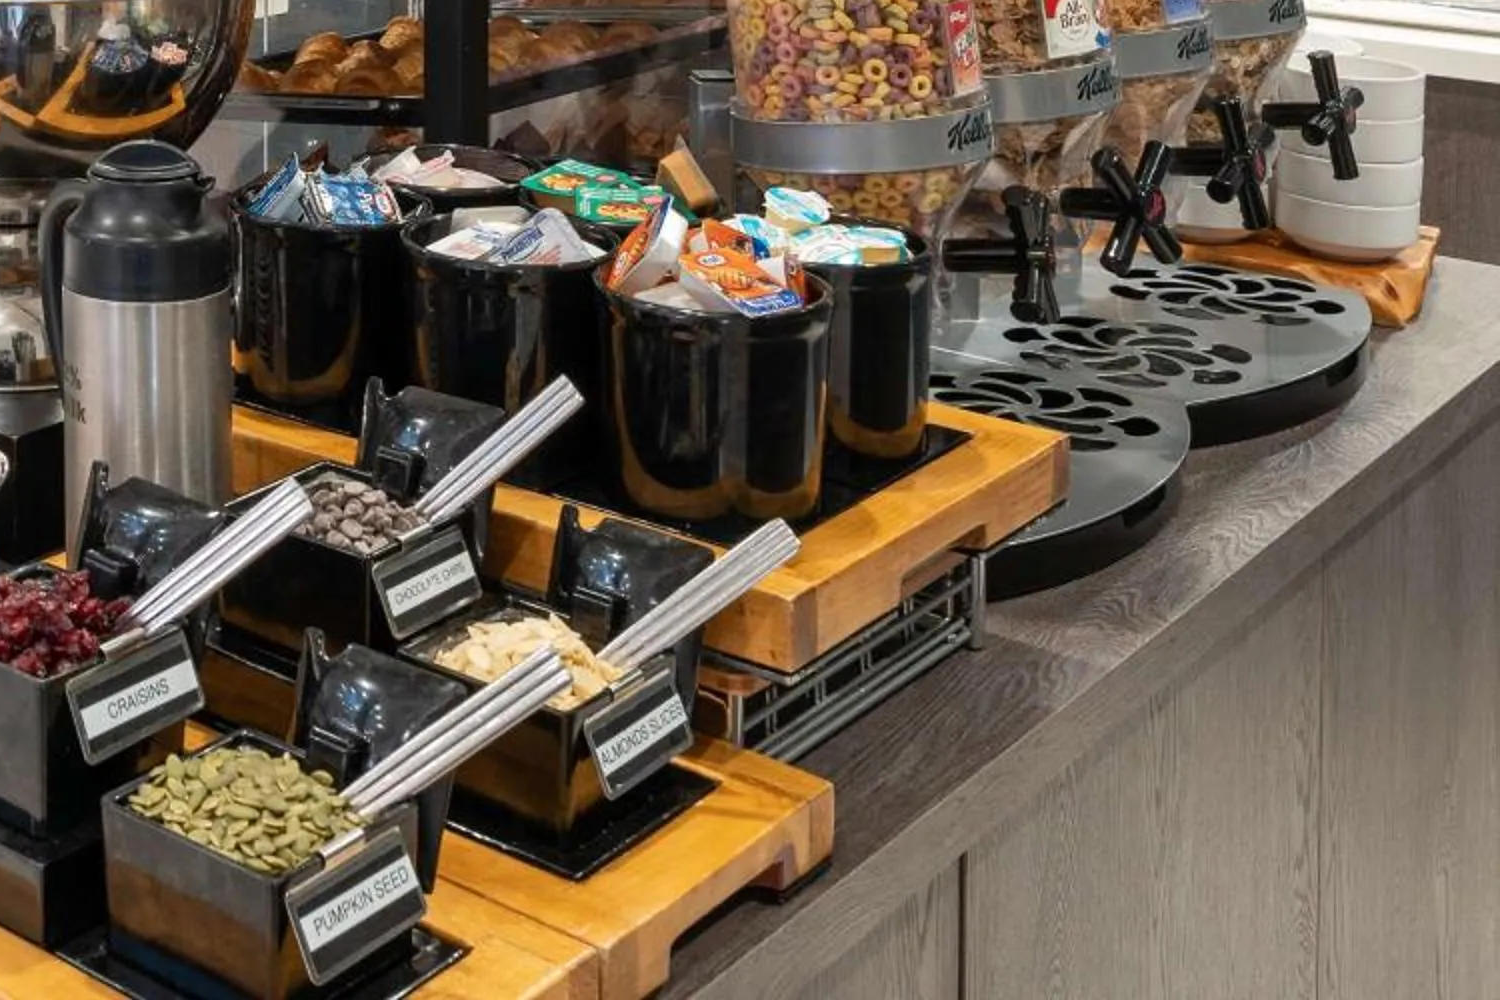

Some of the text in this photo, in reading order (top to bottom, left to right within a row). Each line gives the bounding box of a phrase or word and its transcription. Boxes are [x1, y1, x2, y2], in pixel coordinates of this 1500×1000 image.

[1060, 12, 1088, 29] Bran
[107, 677, 170, 718] CRAISINS
[601, 725, 650, 769] ALMONDS
[313, 865, 409, 936] PUMPKIN SEED
